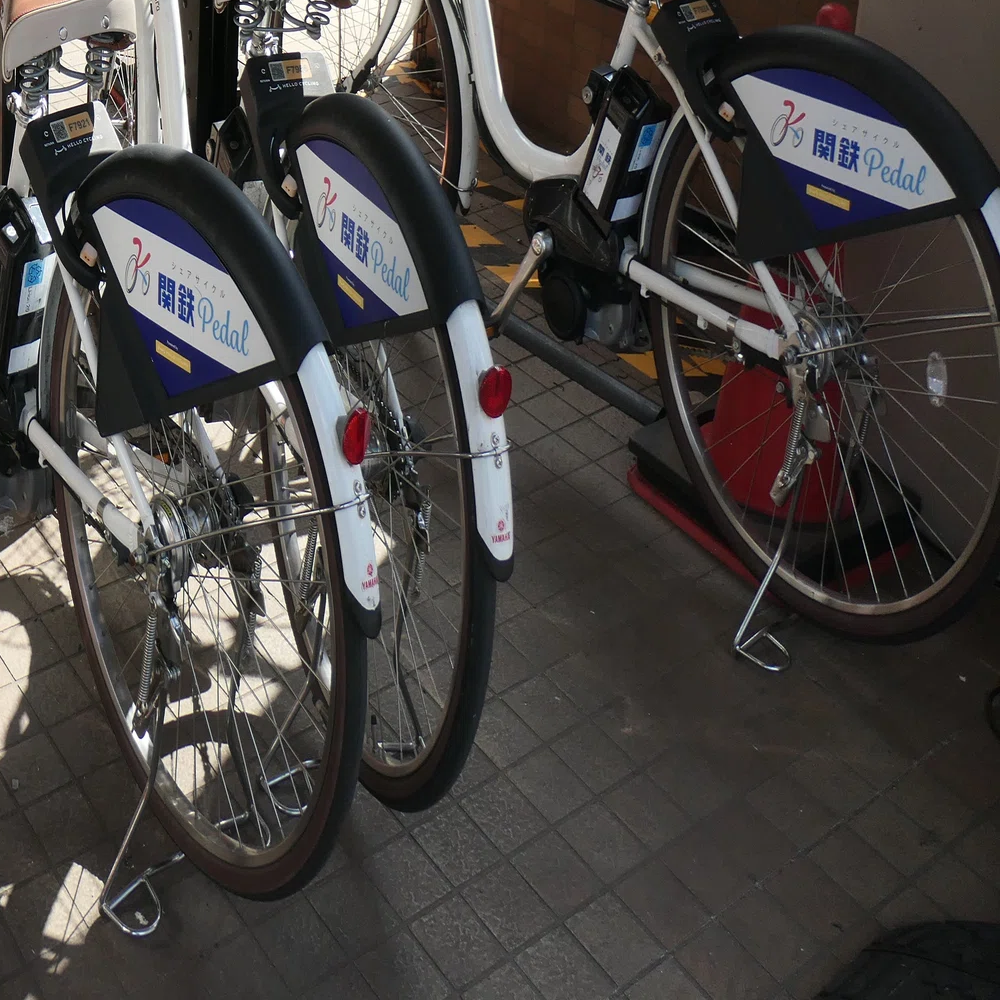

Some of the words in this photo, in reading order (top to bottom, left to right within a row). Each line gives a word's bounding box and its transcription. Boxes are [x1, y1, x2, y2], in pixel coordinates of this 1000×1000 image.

[67, 140, 83, 148] HELLO
[68, 118, 91, 132] F7921
[832, 118, 900, 149] シェアサイクル
[812, 128, 860, 173] 関鉄
[863, 147, 927, 196] Pedal
[352, 204, 393, 245] シェアサイクル
[341, 211, 370, 268] 関鉄
[371, 240, 410, 302] Pedal
[171, 262, 226, 299] シェアサイクル
[157, 271, 195, 328] 関鉄
[197, 297, 250, 357] Pedal
